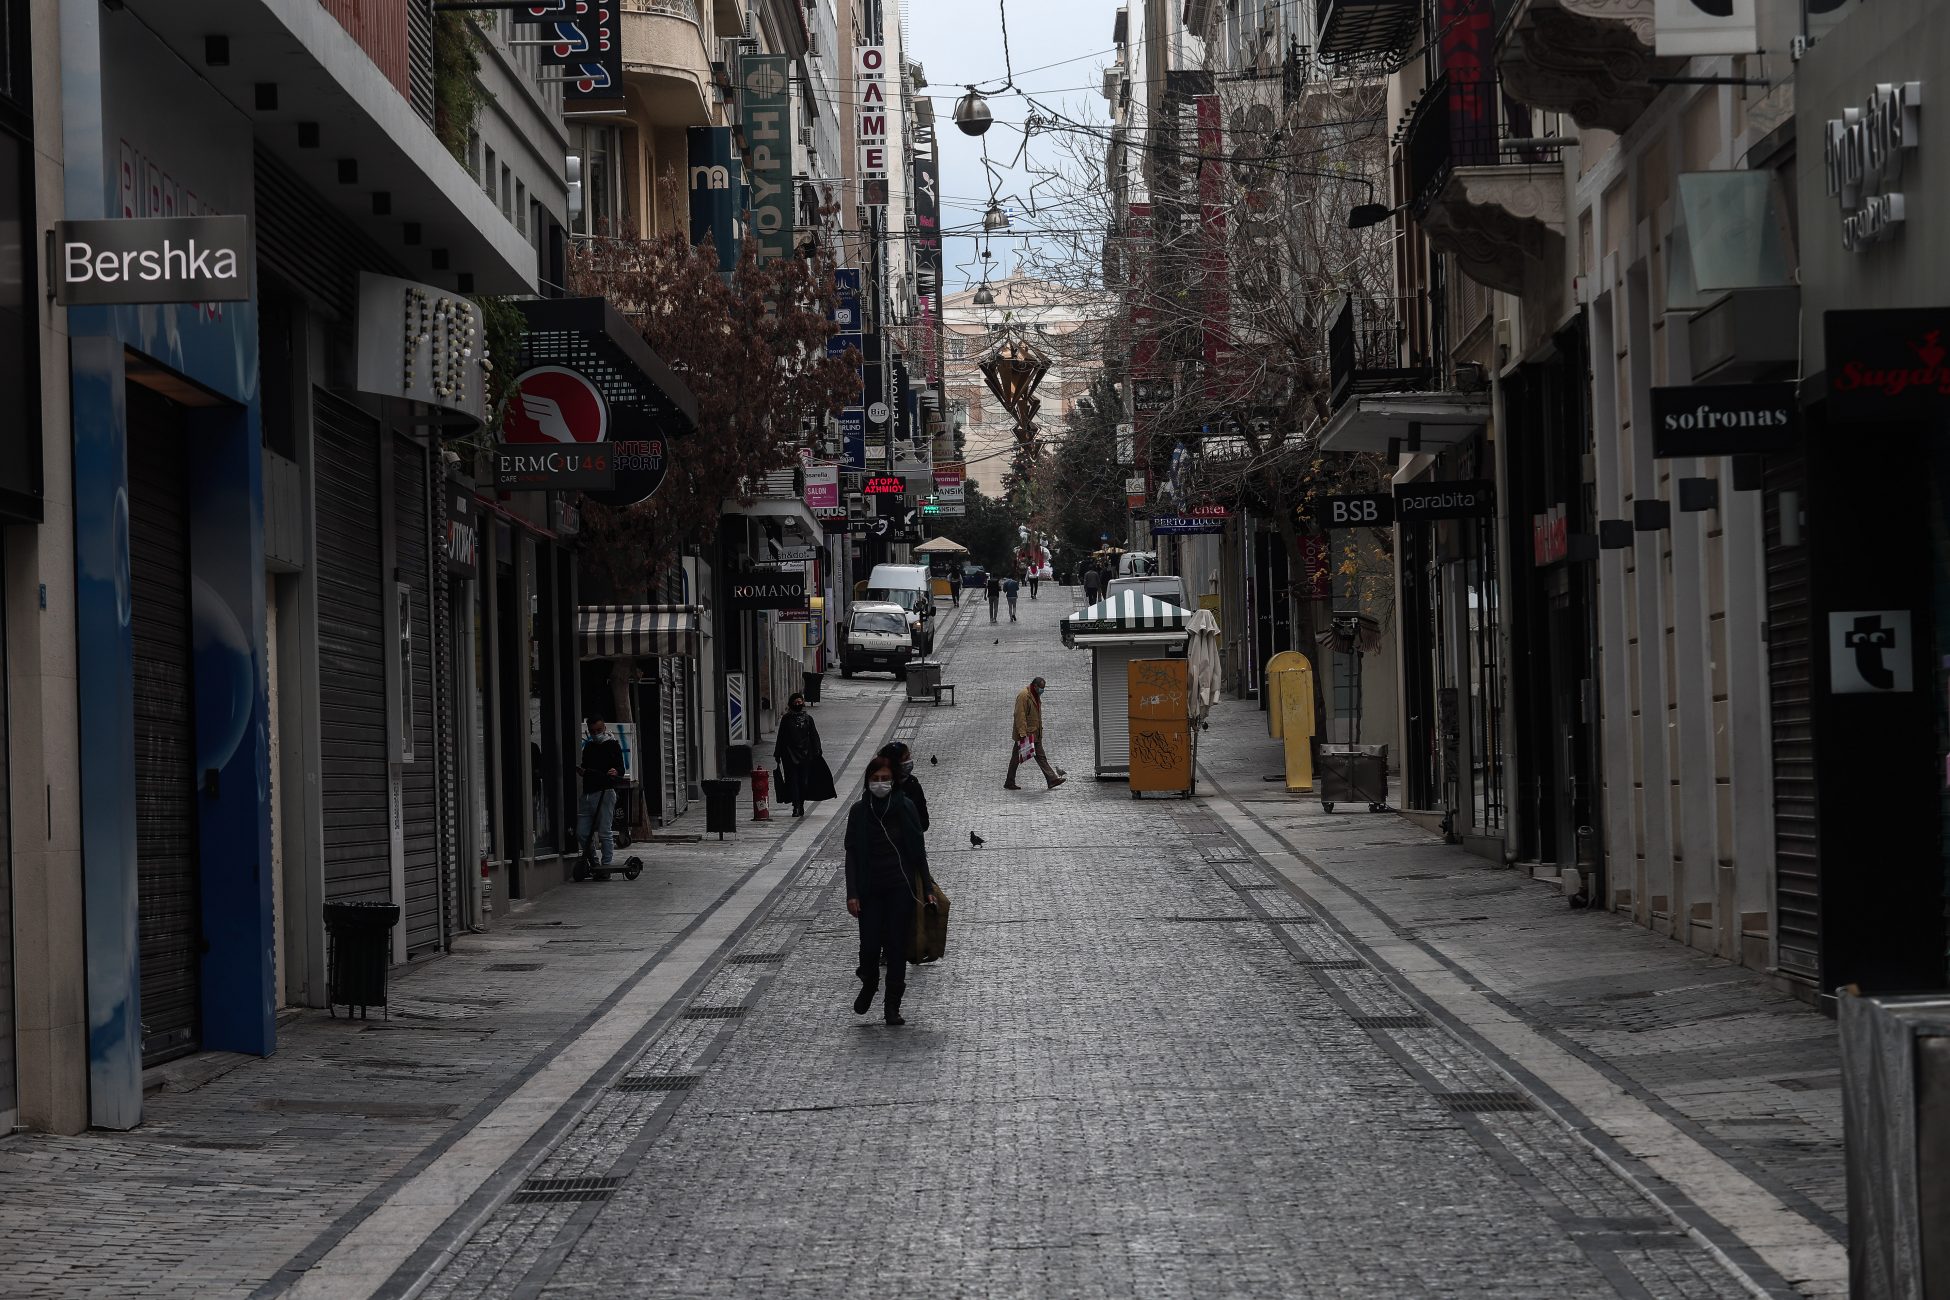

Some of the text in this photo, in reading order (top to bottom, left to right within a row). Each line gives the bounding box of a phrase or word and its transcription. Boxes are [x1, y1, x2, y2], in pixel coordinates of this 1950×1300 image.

[64, 239, 237, 282] Bershka
[870, 408, 886, 416] Big
[1664, 405, 1788, 431] sofronas
[864, 485, 905, 493] ΑΣΗΜΙΟΥ
[868, 478, 899, 486] ΑΓΟΡΑ
[808, 487, 827, 495] SALON
[1402, 491, 1475, 512] parabita
[1332, 500, 1378, 522] BSB
[733, 584, 801, 598] ROMANO
